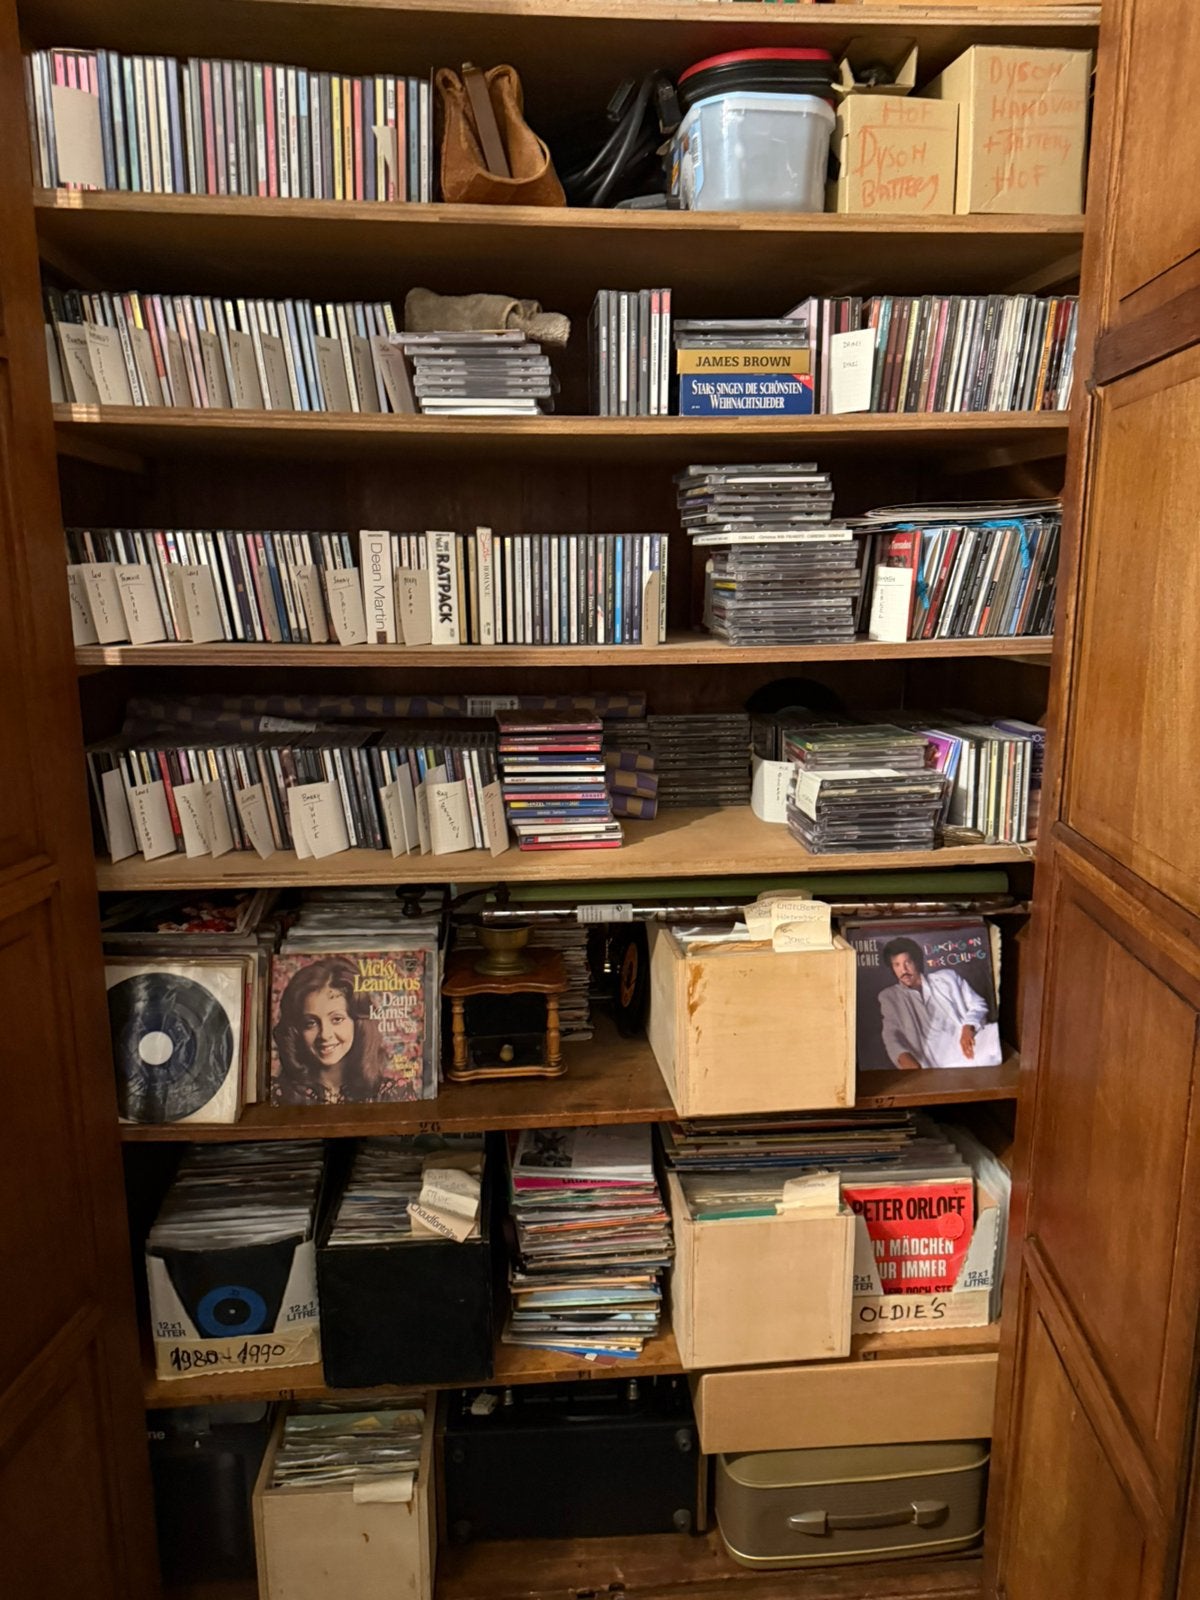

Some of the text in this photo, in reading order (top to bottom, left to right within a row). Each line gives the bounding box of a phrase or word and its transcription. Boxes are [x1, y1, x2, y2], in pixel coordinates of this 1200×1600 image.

[696, 356, 792, 368] JAMES BROWN
[745, 382, 759, 395] DIE
[370, 542, 388, 630] Dean Martin
[436, 553, 453, 624] RATPACK
[358, 959, 396, 977] Vicky
[857, 953, 880, 967] ICHIE
[353, 974, 421, 993] Leandros
[382, 991, 417, 1007] Dann
[853, 1195, 966, 1223] PETER ORLOFF
[889, 1235, 954, 1257] MÄDCHEN
[901, 1259, 947, 1278] IMMER
[964, 1277, 990, 1288] LITRE
[859, 1297, 947, 1323] OLDIE'S
[156, 1329, 187, 1338] LITER
